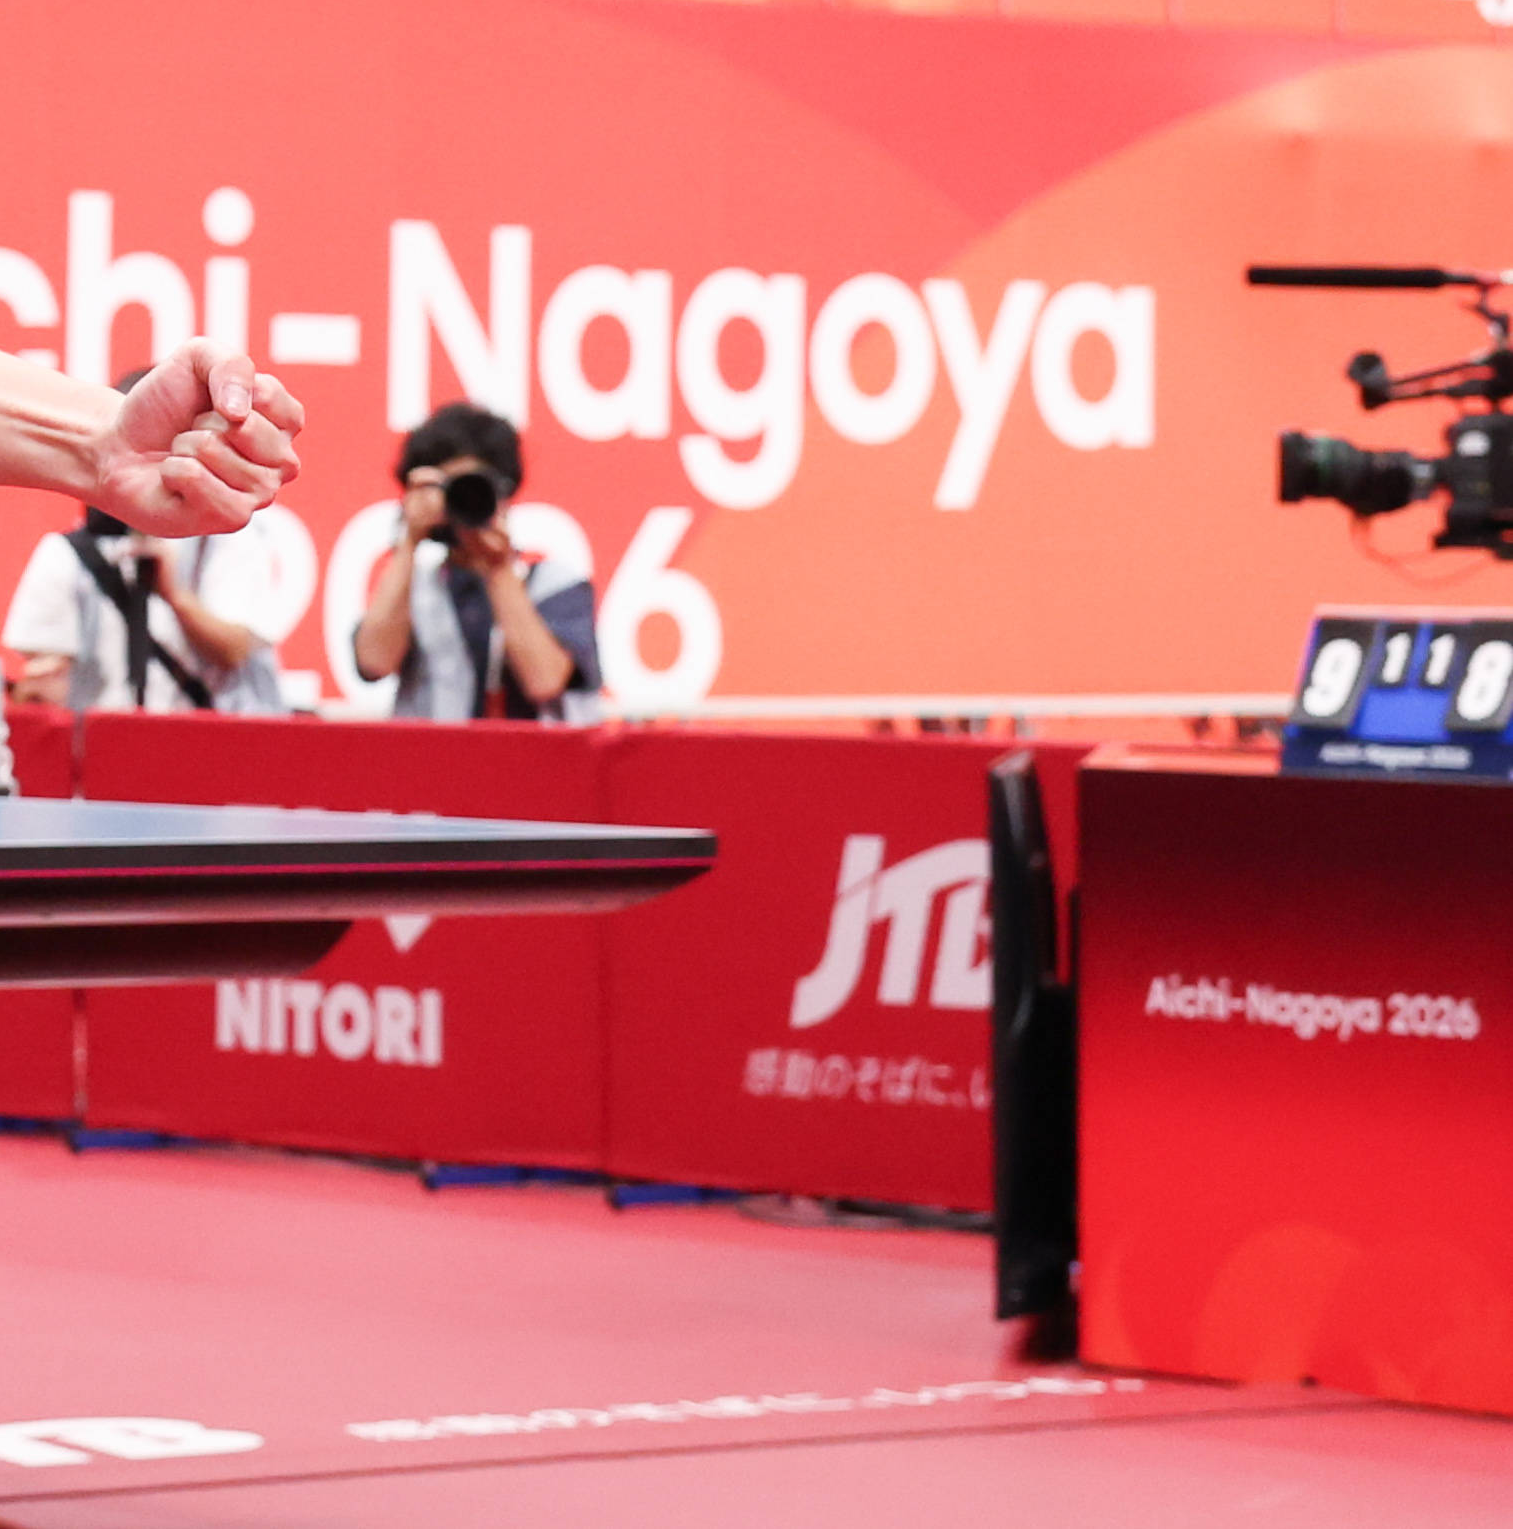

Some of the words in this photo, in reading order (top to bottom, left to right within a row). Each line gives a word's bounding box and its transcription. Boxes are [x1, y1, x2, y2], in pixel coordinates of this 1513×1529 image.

[1302, 637, 1362, 717] 9
[1381, 631, 1412, 685] 1
[1426, 633, 1456, 686] 1
[216, 977, 444, 1068] NITORI
[1145, 972, 1382, 1042] Aichi-Nagoya
[1387, 991, 1482, 1041] 2026
